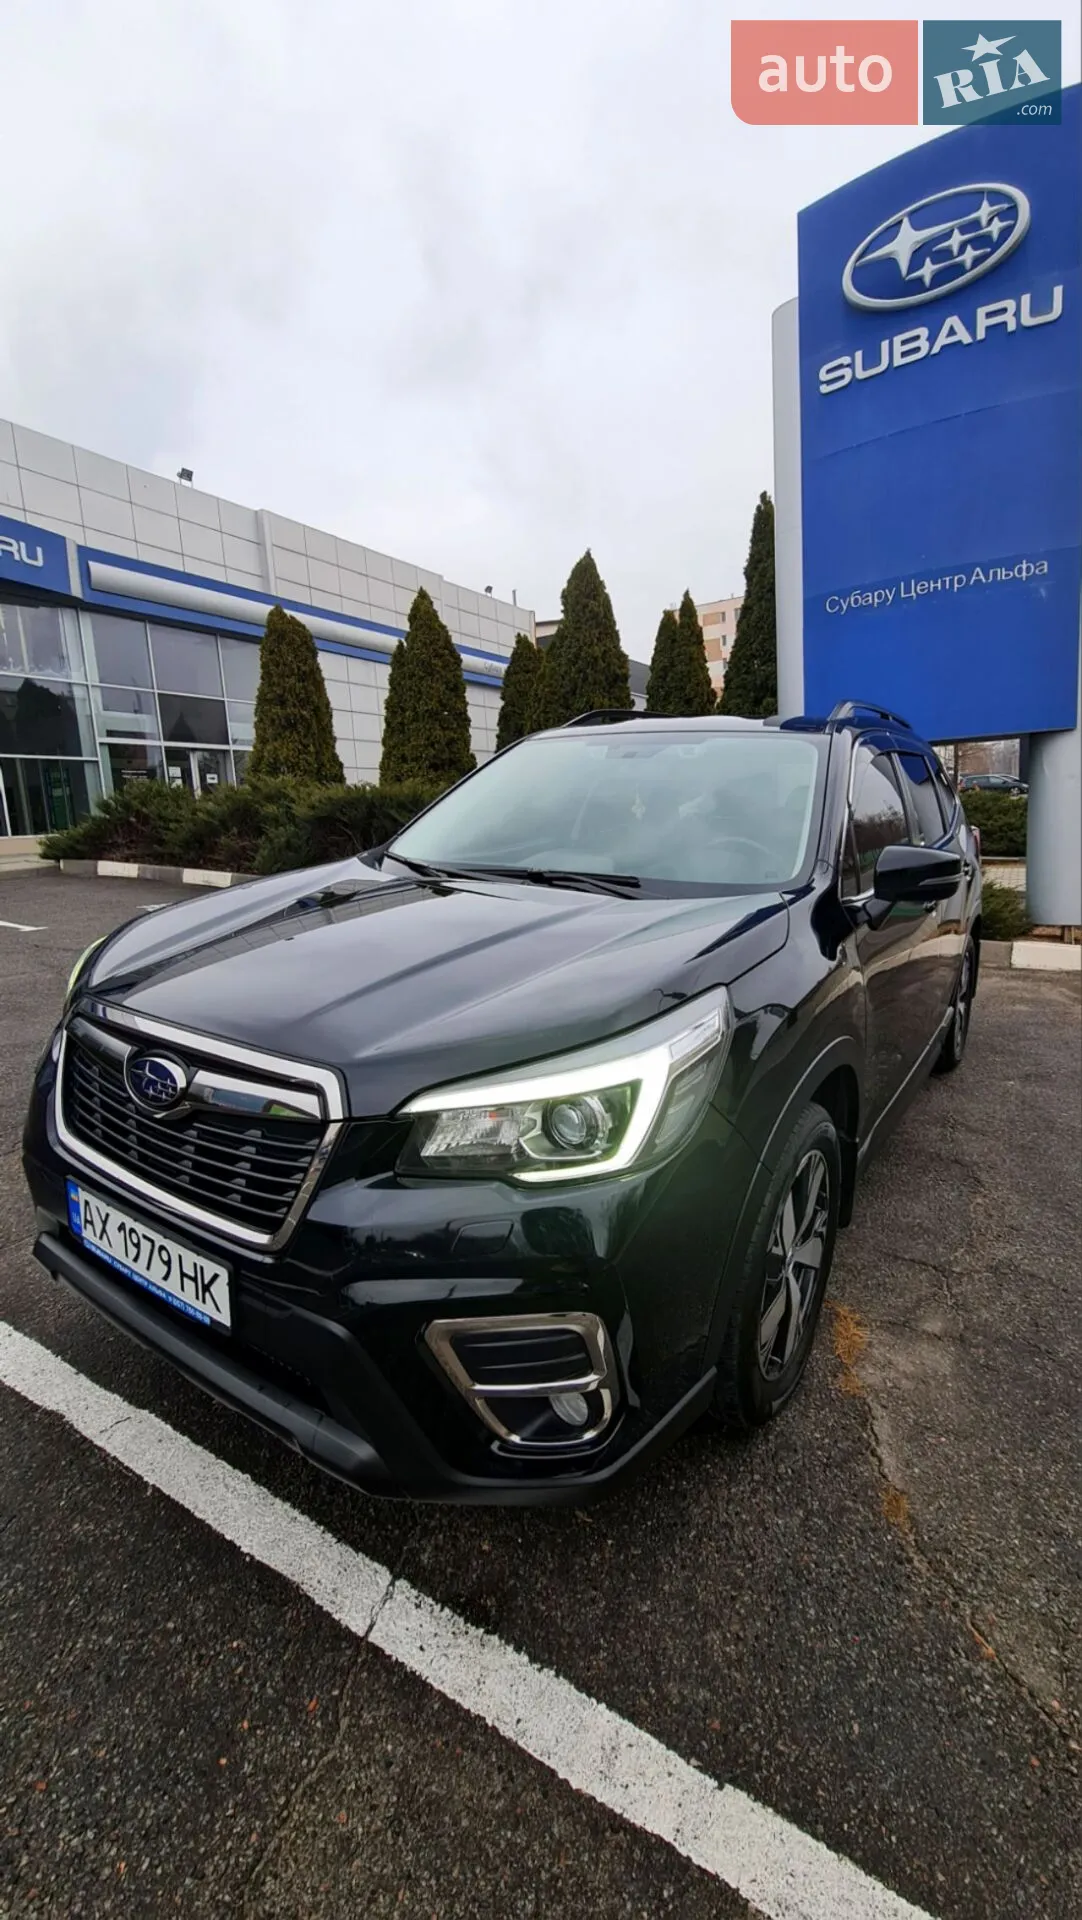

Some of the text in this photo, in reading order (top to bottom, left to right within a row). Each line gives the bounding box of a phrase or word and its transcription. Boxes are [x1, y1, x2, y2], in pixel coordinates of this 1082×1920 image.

[818, 284, 1064, 396] SUBARU
[825, 559, 1049, 615] Субару Центр Альфа
[83, 1199, 113, 1249] AX
[117, 1220, 172, 1282] 1979
[177, 1253, 223, 1315] HK
